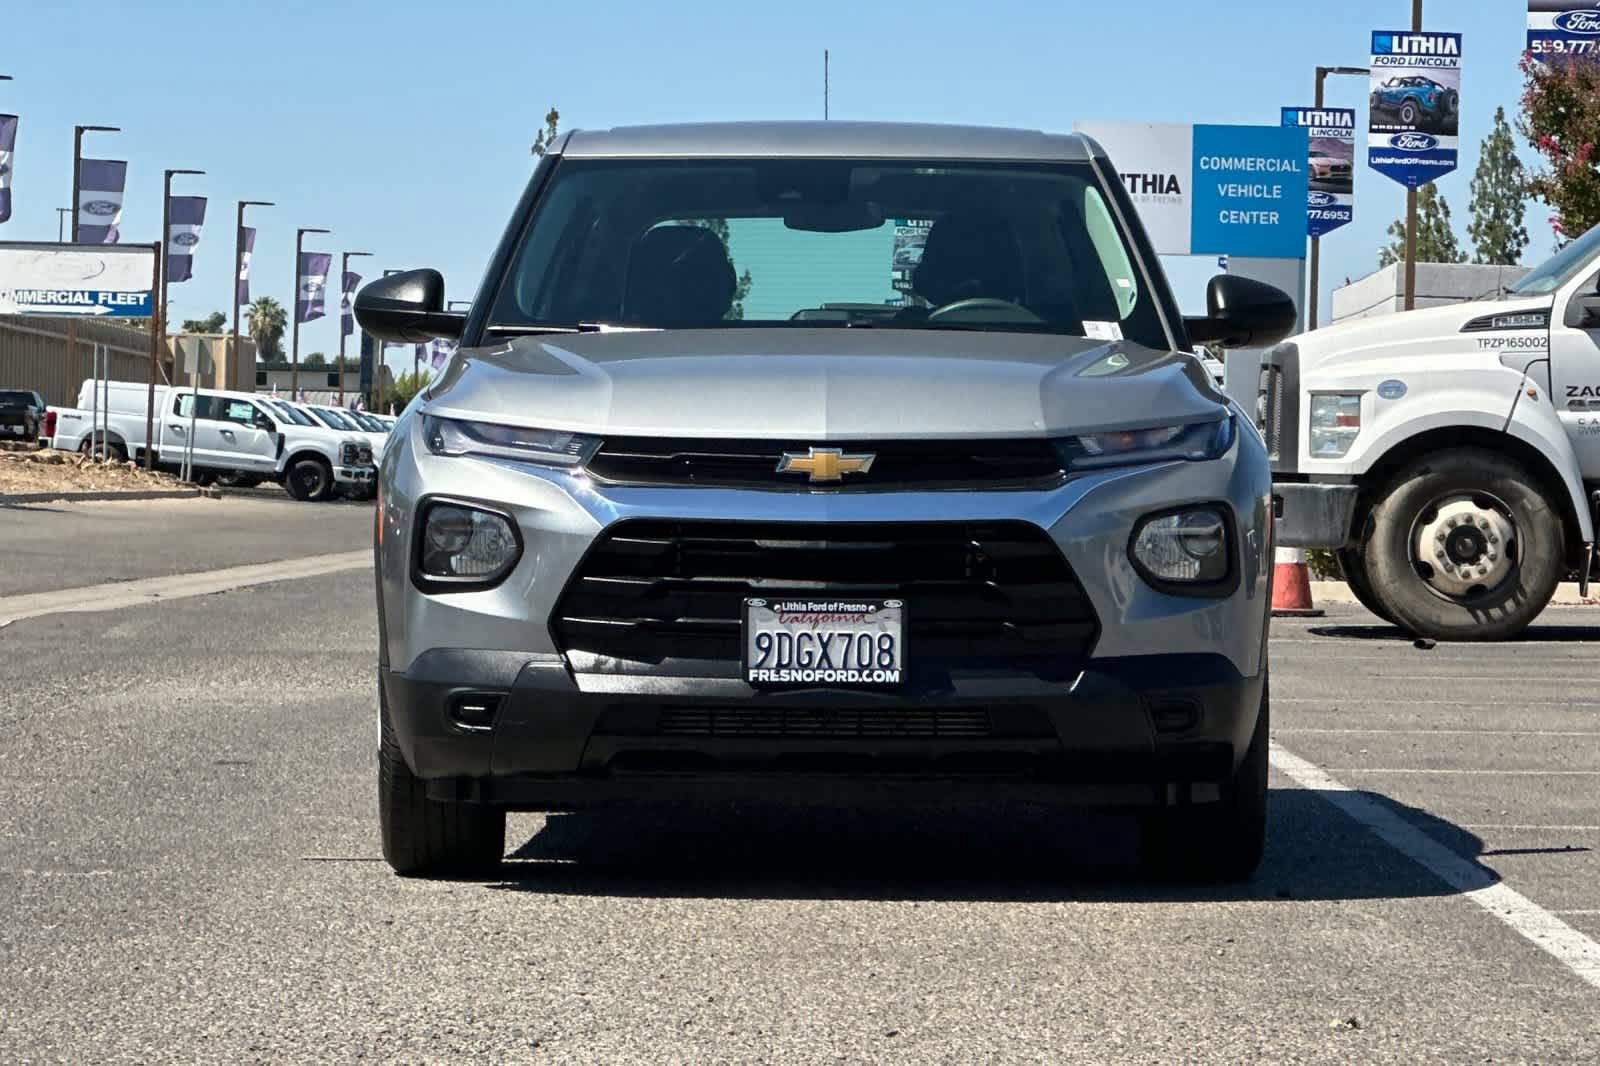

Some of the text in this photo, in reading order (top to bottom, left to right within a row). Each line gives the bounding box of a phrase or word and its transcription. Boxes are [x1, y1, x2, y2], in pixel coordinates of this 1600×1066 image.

[1392, 36, 1458, 54] LITHIA
[1374, 56, 1457, 67] FORD LINCOLN
[1297, 110, 1352, 127] LITHIA
[1311, 129, 1352, 137] LINCOLN
[1397, 134, 1429, 148] Ford
[1200, 157, 1300, 172] COMMERCIAL
[1120, 174, 1181, 194] THIA
[1217, 184, 1282, 198] VEHICLE
[1219, 211, 1279, 225] CENTER
[0, 290, 148, 305] OMMERCIAL FLEET
[1477, 337, 1548, 349] TPZP165002
[782, 602, 868, 613] Lithia Ford of Fresno
[778, 612, 876, 630] California
[755, 632, 895, 669] 9DGX708
[749, 669, 900, 683] FRESNOFORD.COM
